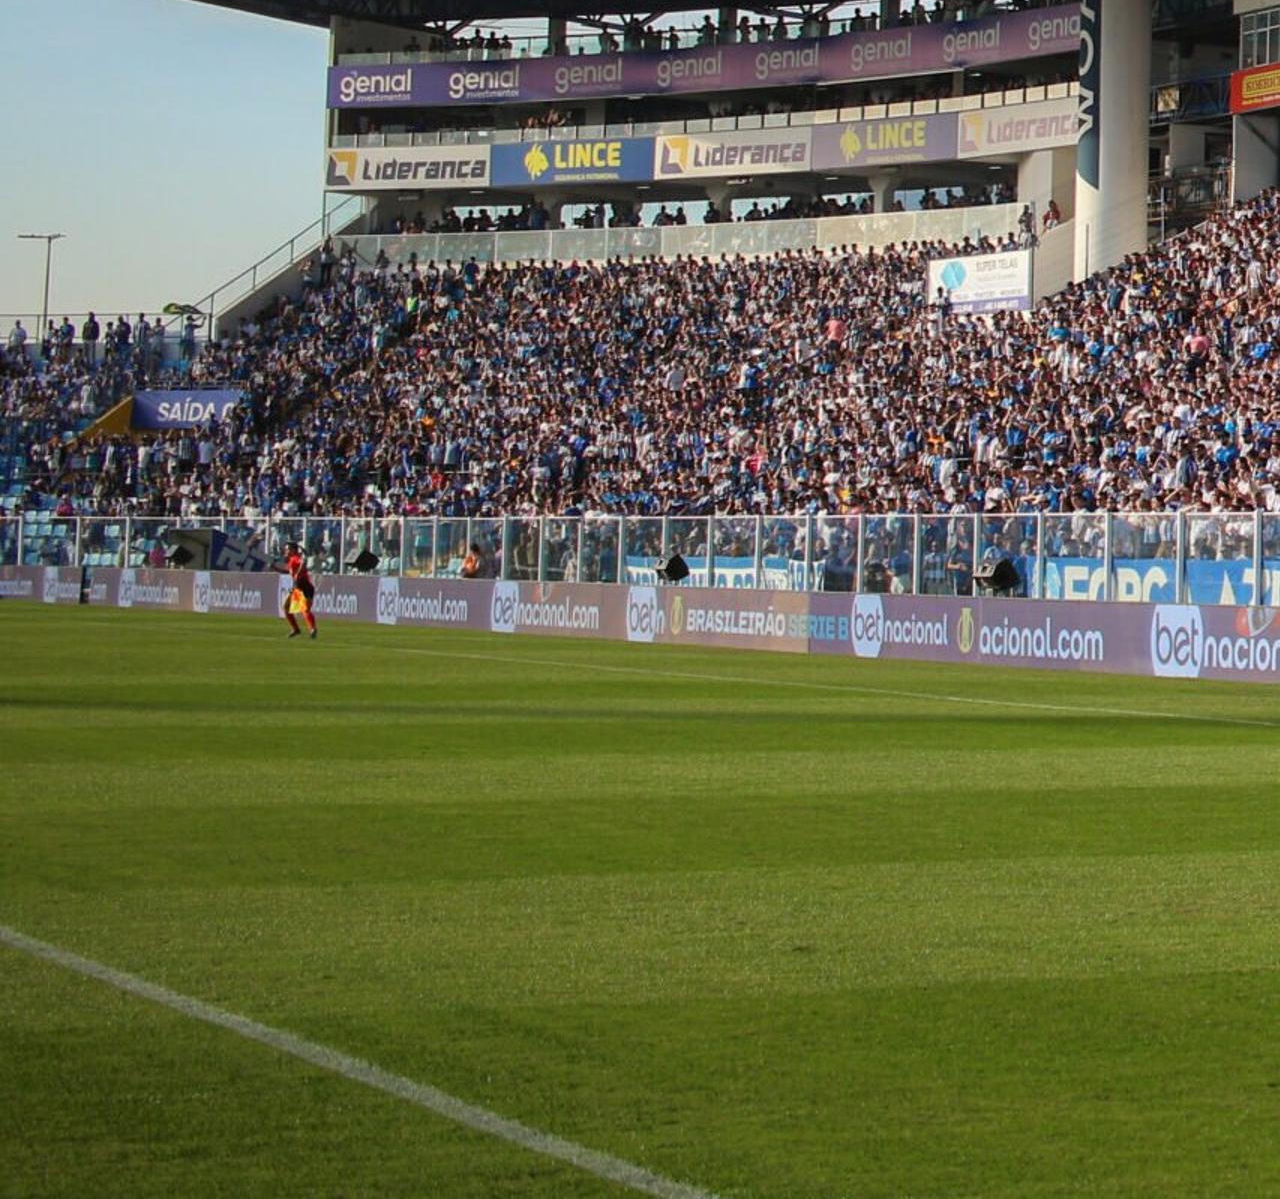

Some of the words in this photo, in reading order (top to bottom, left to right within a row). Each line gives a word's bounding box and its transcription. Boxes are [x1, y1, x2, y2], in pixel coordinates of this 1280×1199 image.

[943, 21, 1000, 63] genial
[1028, 15, 1080, 51] genia
[657, 50, 722, 87] genial
[755, 43, 819, 80] genial
[850, 32, 911, 72] genial
[340, 69, 413, 102] genial
[449, 65, 520, 99] genial
[555, 57, 623, 94] genial
[866, 120, 926, 150] LINCE
[554, 141, 622, 169] LINCE
[686, 605, 786, 636] BRASILEIRÃO
[838, 616, 849, 641] B
[979, 617, 1104, 661] acional.com
